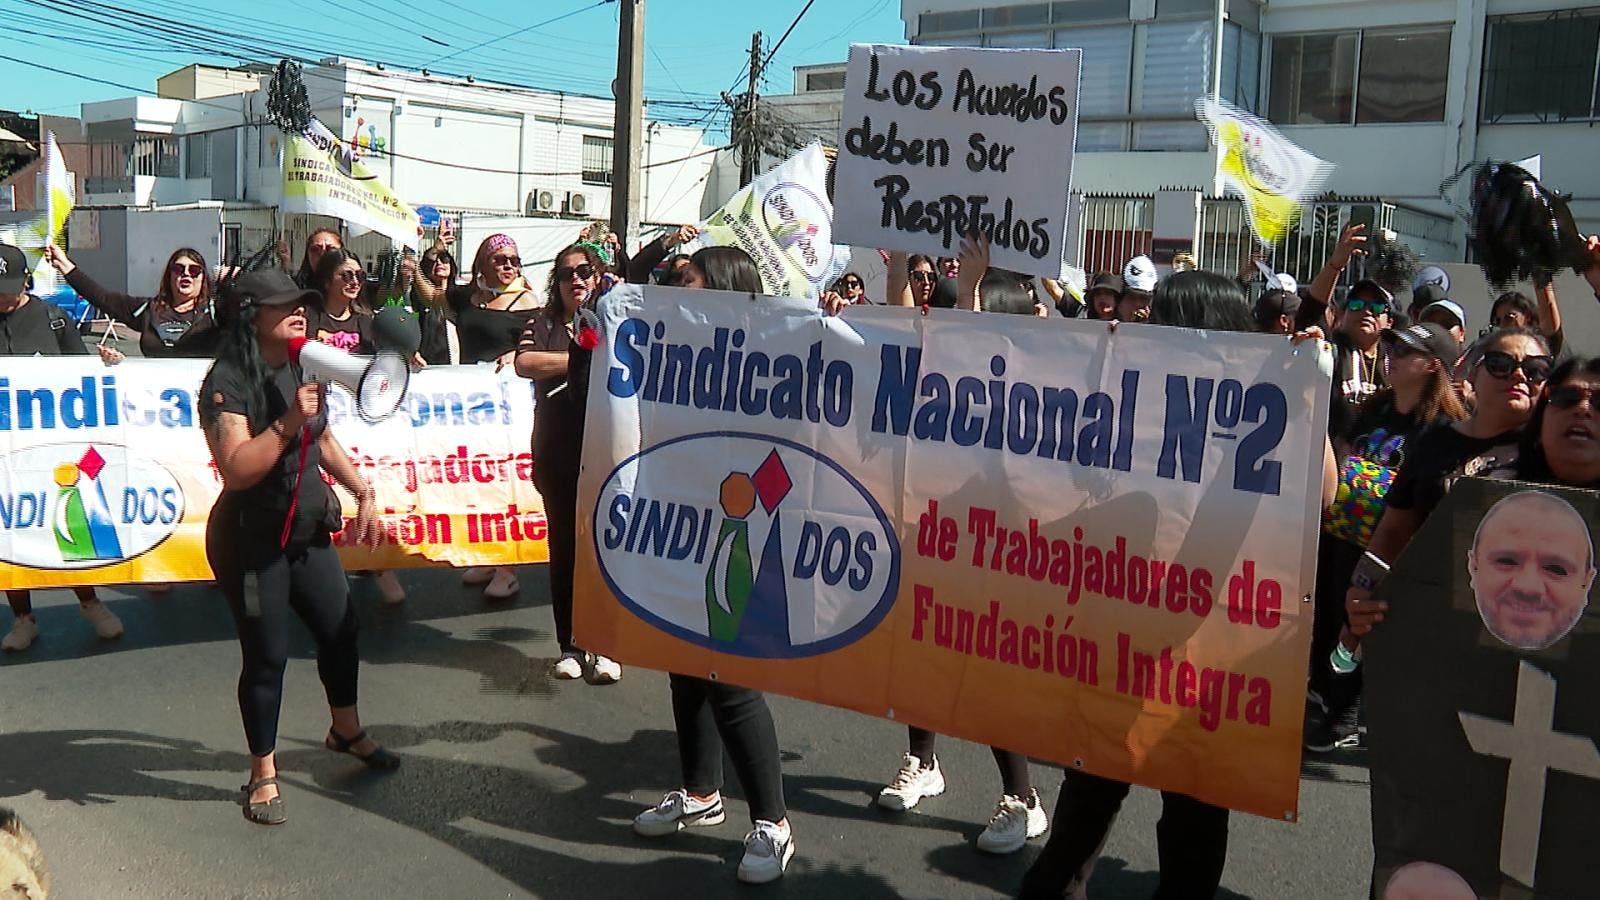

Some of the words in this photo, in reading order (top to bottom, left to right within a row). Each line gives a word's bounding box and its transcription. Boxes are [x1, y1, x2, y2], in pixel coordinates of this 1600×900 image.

[952, 68, 1068, 125] Acuerdos
[844, 115, 950, 168] deben
[606, 317, 854, 428] Sindicato
[871, 343, 1140, 472] Nacional
[0, 491, 47, 529] NDI
[122, 486, 177, 526] DOS
[467, 503, 548, 543] inte
[604, 493, 713, 564] SINDI
[793, 520, 877, 592] DOS
[916, 499, 959, 562] de
[968, 505, 1214, 617] Trabajadores
[1227, 559, 1283, 630] de
[911, 583, 1100, 687] Fundación
[1115, 632, 1272, 733] Integra
